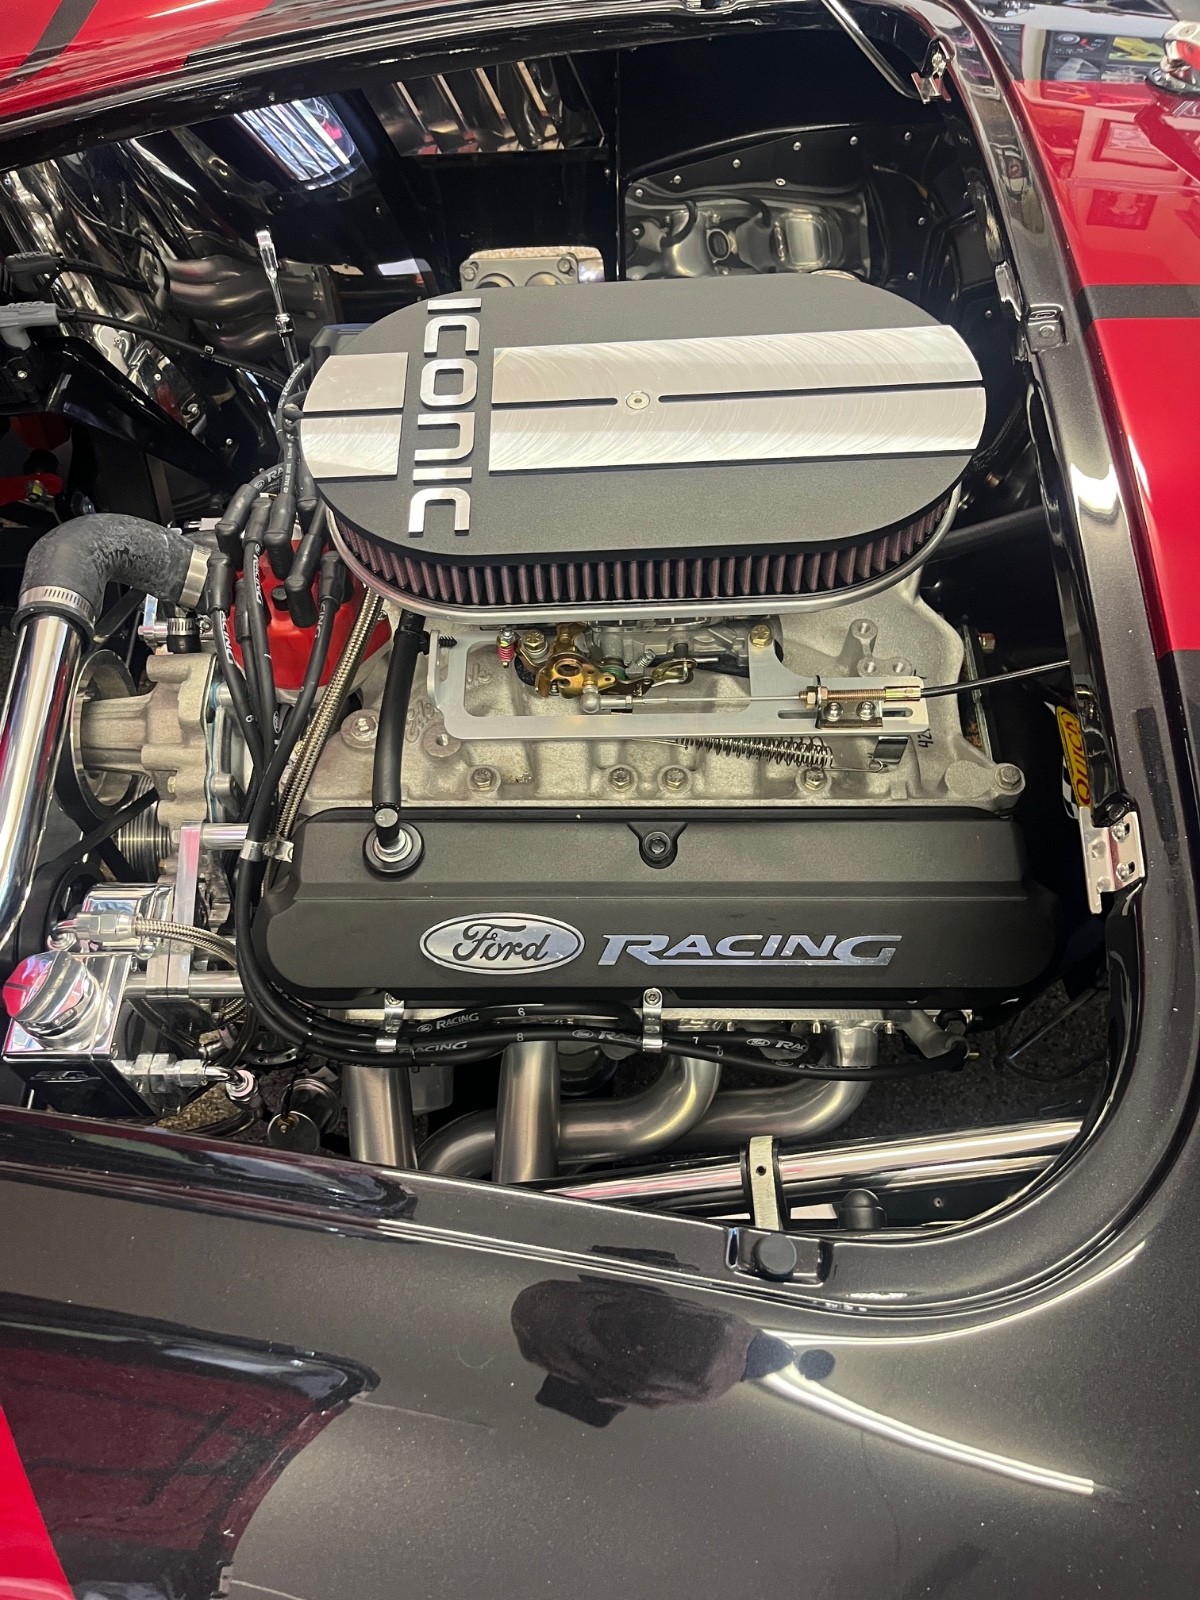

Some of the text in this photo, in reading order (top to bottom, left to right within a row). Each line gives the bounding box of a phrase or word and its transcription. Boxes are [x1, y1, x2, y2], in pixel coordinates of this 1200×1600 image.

[220, 610, 234, 664] ACING
[452, 922, 902, 967] Ford RACING
[436, 1012, 479, 1030] RACING
[518, 1007, 526, 1016] 6
[516, 1032, 523, 1042] 8
[692, 1036, 699, 1045] 7
[775, 1040, 808, 1051] RAC
